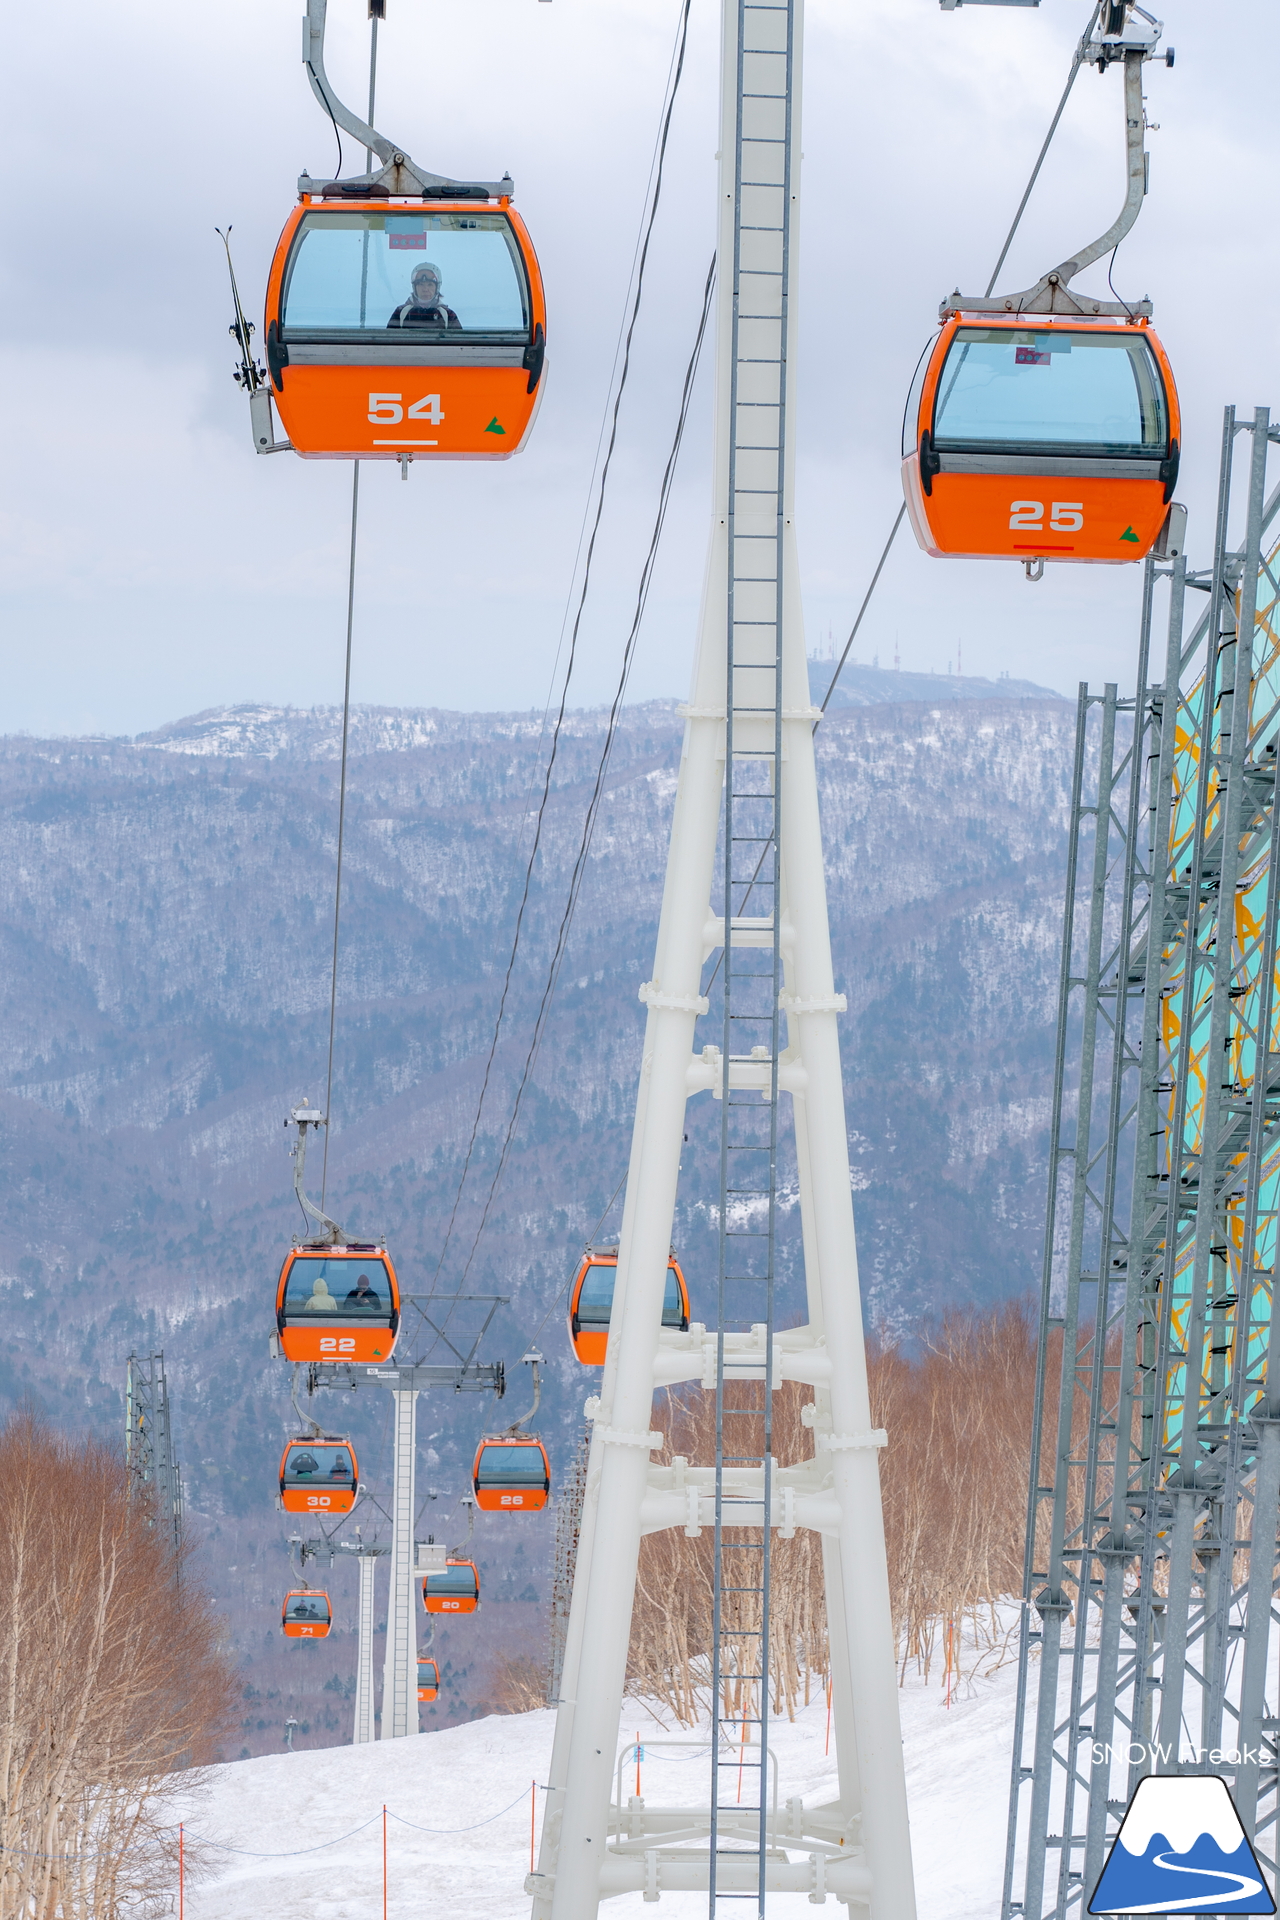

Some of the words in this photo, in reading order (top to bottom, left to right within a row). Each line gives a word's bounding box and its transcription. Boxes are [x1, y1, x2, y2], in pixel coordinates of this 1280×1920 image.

[367, 392, 445, 426] 54
[1009, 500, 1084, 532] 25
[319, 1337, 356, 1352] 22
[307, 1496, 331, 1506] 30
[500, 1495, 524, 1505] 26
[441, 1601, 460, 1609] 20
